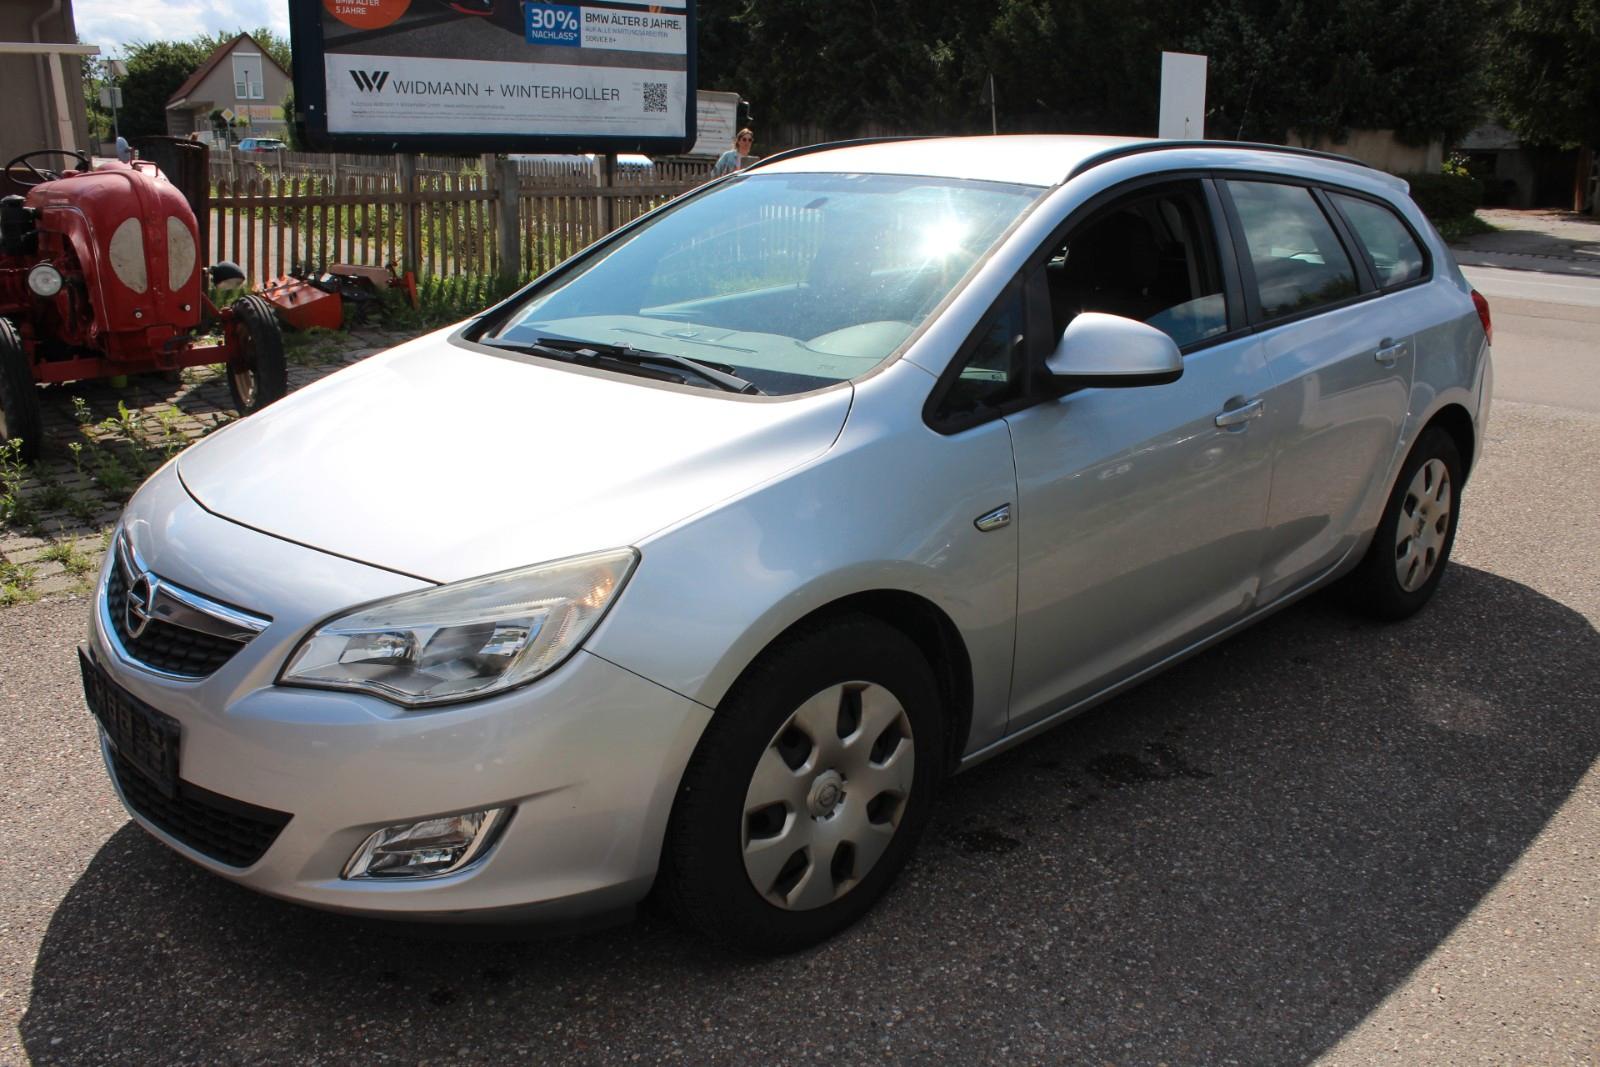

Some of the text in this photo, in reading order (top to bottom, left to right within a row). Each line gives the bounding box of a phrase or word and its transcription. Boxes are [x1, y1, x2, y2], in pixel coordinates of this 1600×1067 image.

[341, 6, 368, 15] JAHRE
[531, 8, 578, 30] 30%
[585, 12, 609, 24] BMW
[611, 12, 642, 28] ÄLTER
[642, 18, 649, 28] 8
[393, 80, 479, 96] WIDMANN
[484, 85, 495, 96] +
[500, 84, 620, 101] WINTERHOLLER
